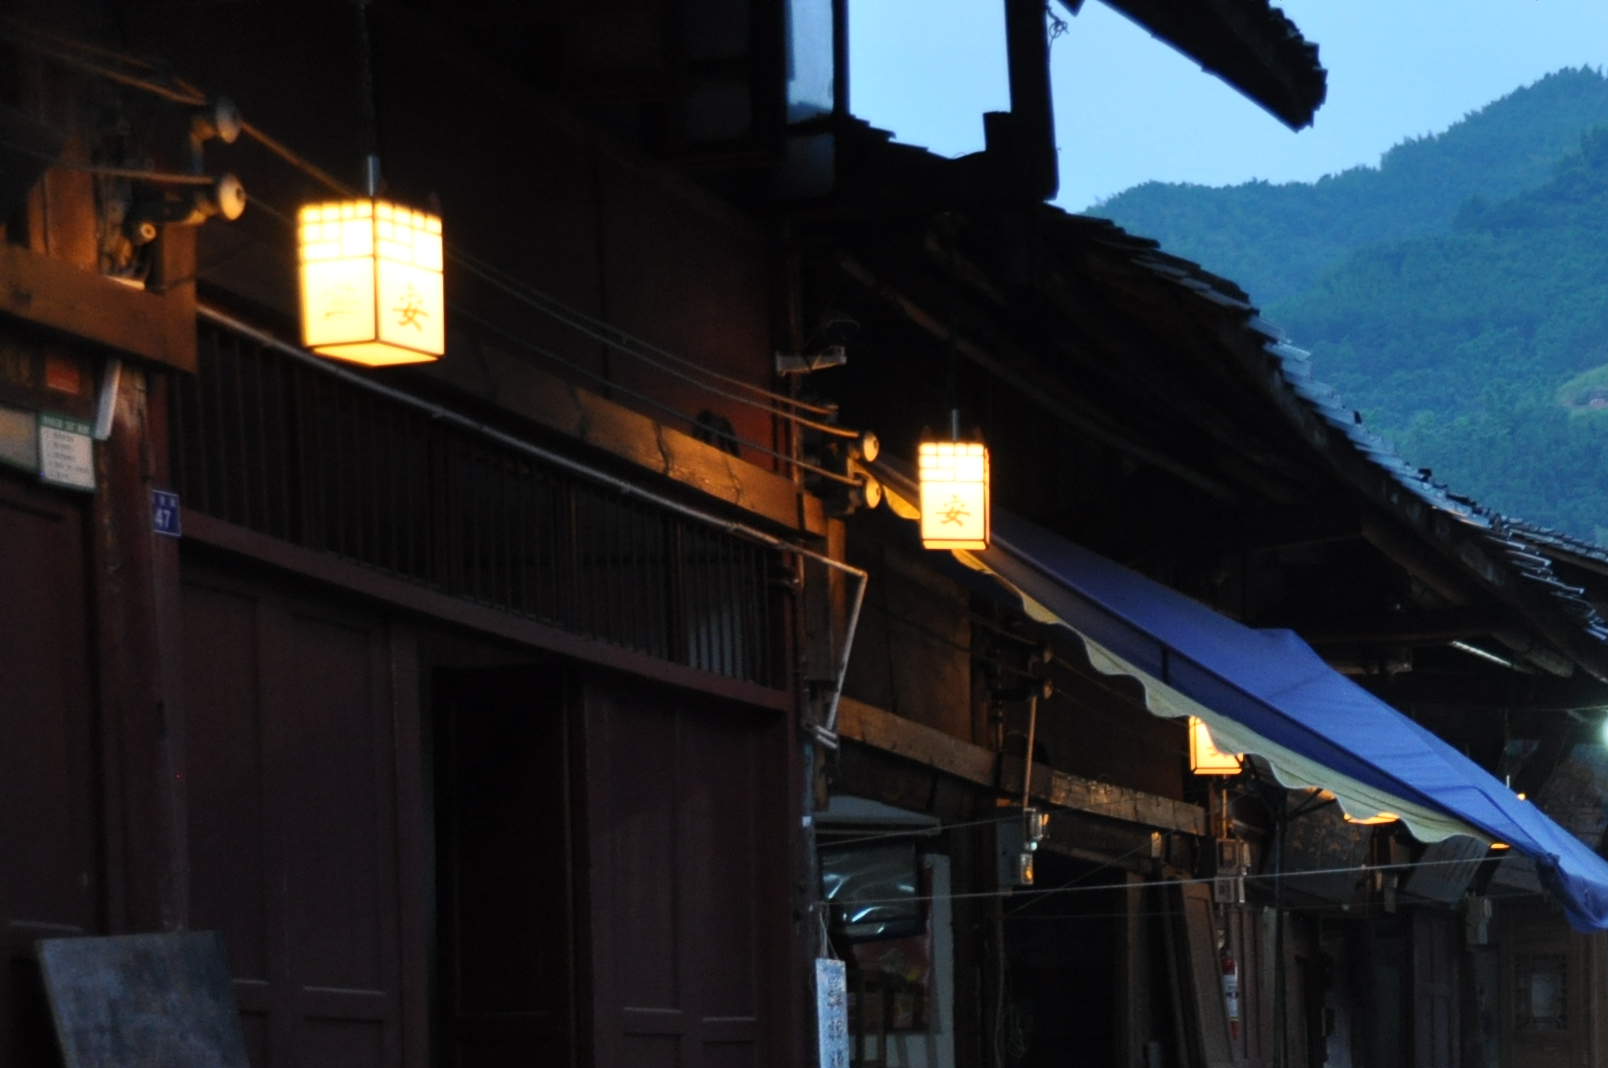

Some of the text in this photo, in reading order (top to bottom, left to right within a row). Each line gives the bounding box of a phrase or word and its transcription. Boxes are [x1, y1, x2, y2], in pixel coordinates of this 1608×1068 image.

[392, 281, 429, 333] 安
[154, 508, 171, 530] 47
[935, 494, 971, 527] 安
